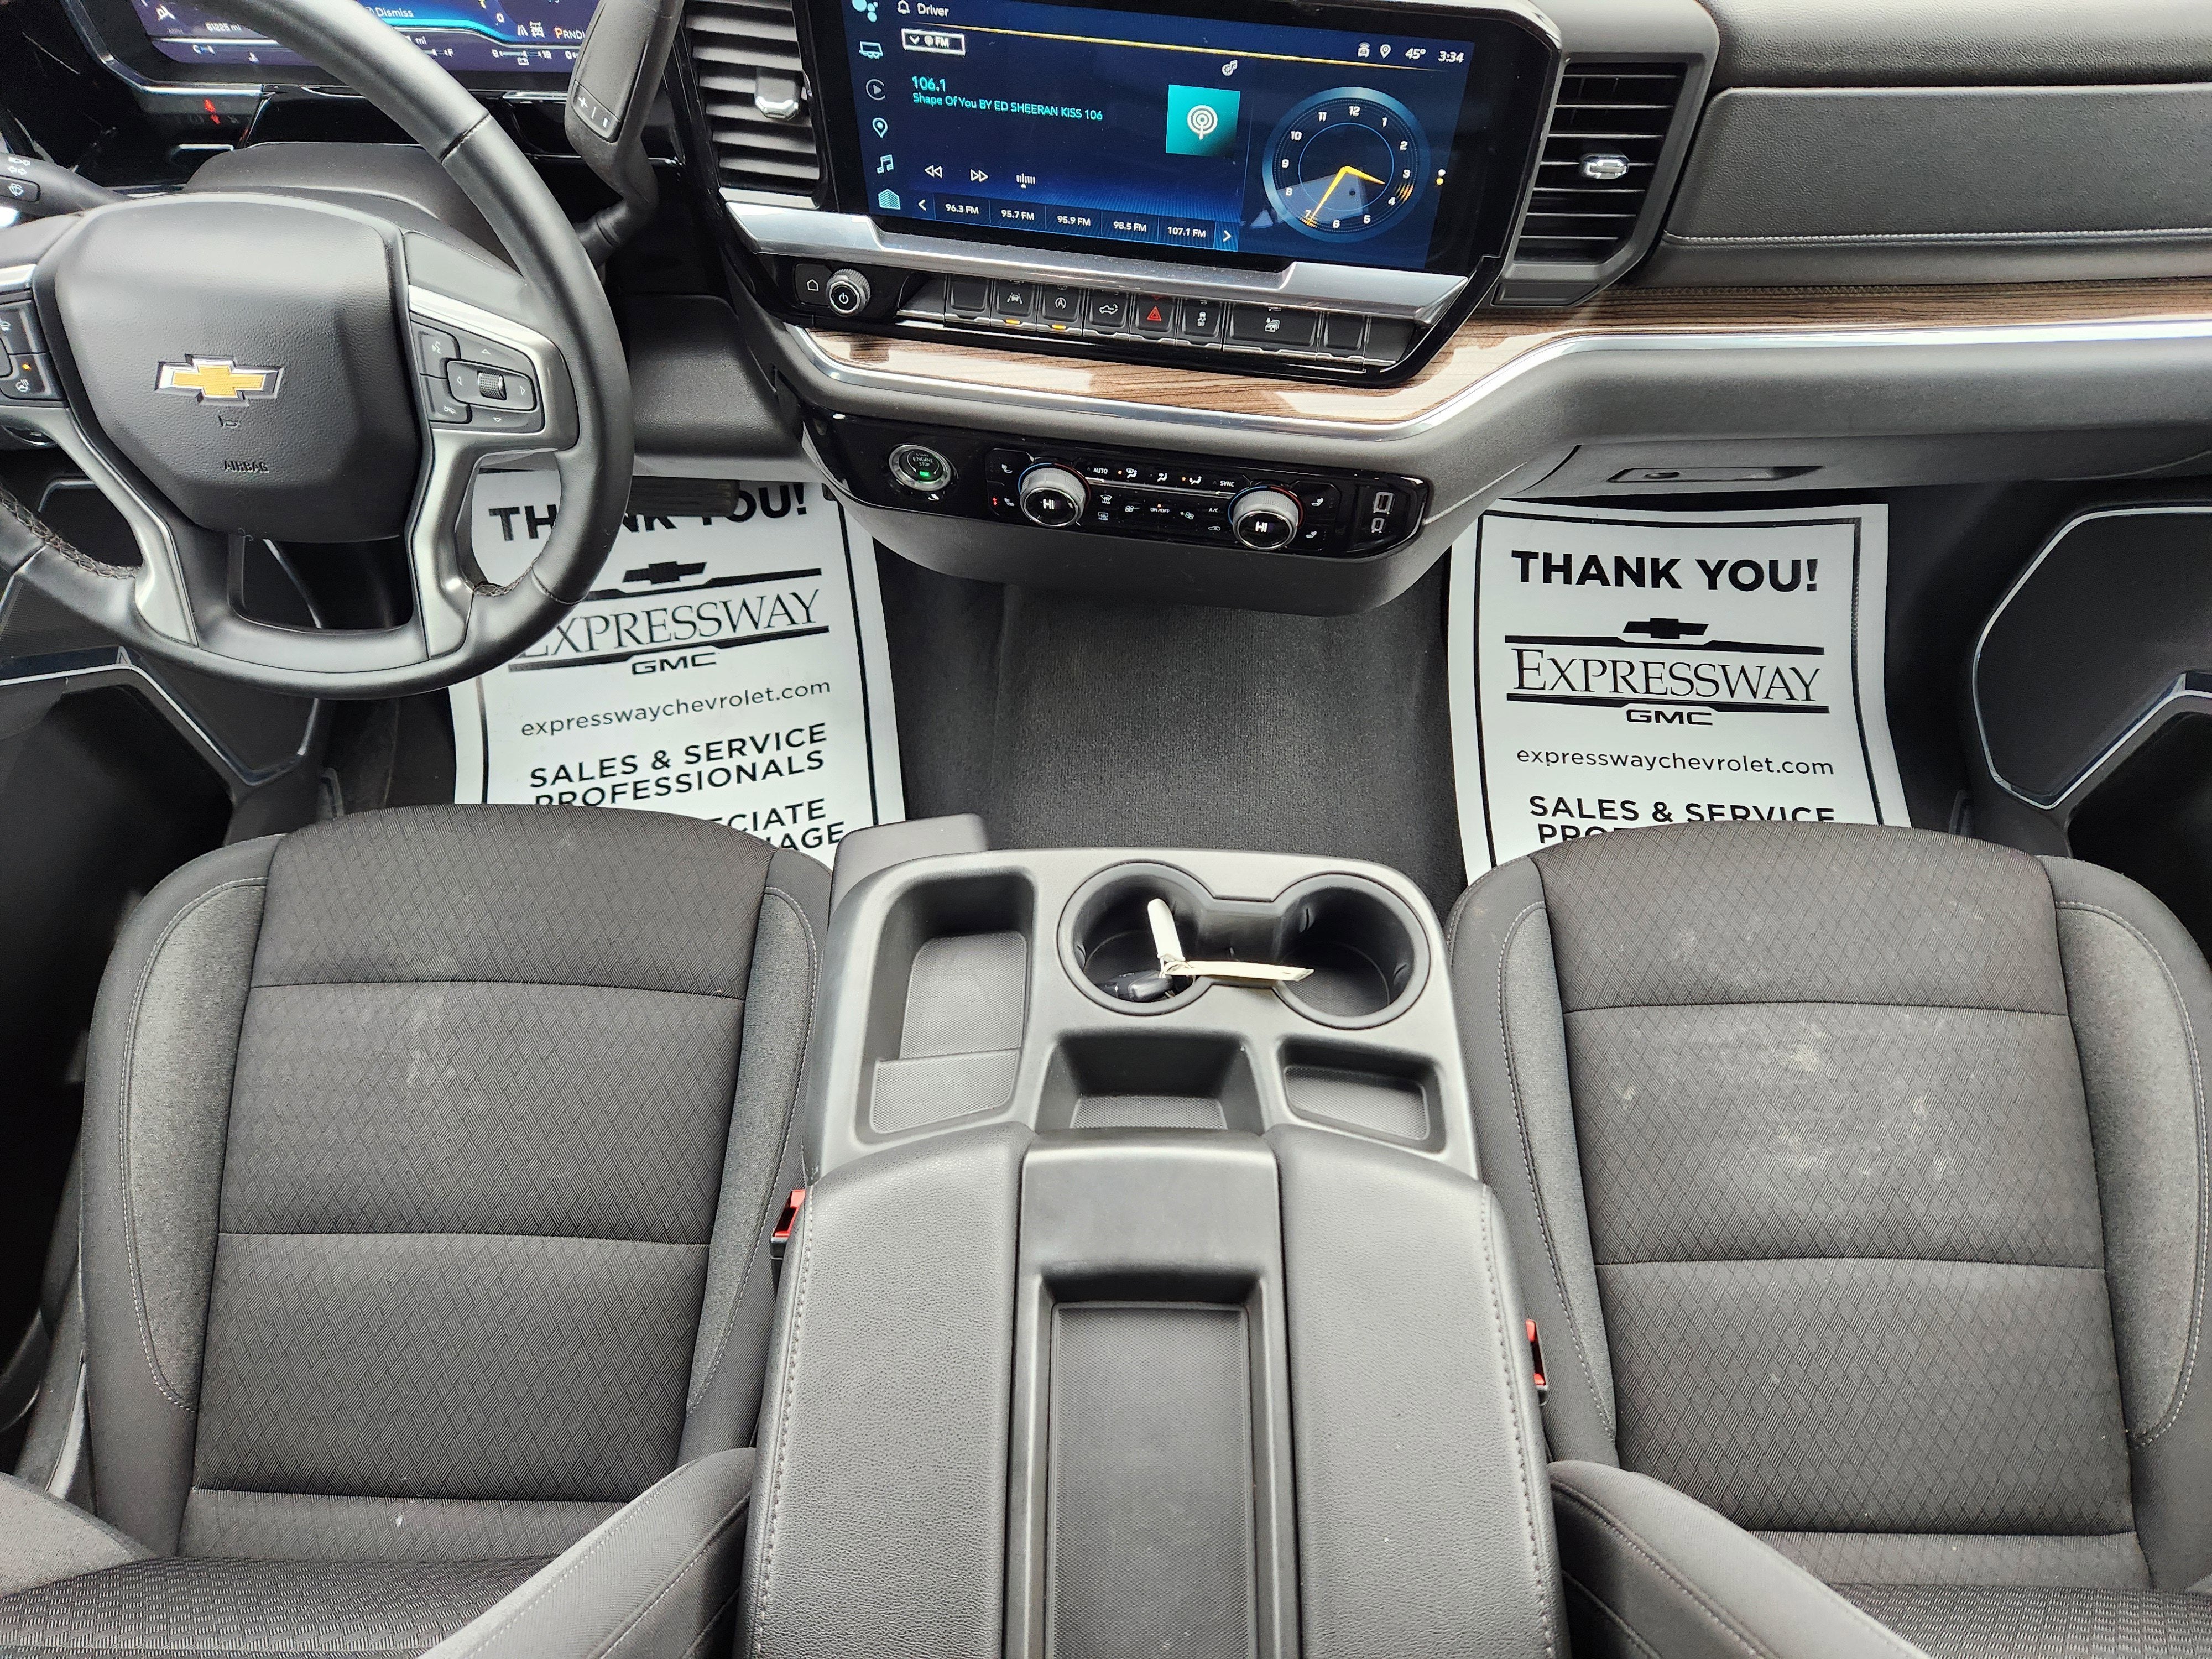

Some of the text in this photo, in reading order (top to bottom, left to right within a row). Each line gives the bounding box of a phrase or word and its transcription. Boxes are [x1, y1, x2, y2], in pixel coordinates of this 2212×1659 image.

[375, 7, 414, 17] Dismiss
[917, 3, 950, 18] Driver
[935, 36, 950, 48] FM
[1405, 48, 1464, 63] 45° 3:34
[912, 76, 946, 92] 106.1
[913, 92, 1103, 121] Shape Of You BY ED SHEERAN KISS 106
[1349, 106, 1360, 117] 12
[1318, 112, 1327, 122] 11
[1383, 117, 1387, 128] 1
[1291, 131, 1302, 141] 10
[1400, 141, 1408, 151] 2
[1282, 159, 1289, 169] 9
[1402, 169, 1411, 179] 3
[1286, 187, 1292, 196] 8
[1388, 197, 1396, 206] 4
[945, 204, 979, 215] 96.3 FM
[1001, 209, 1035, 221] 95.7 FM
[1057, 215, 1091, 226] 95.9 FM
[1333, 220, 1340, 228] 6
[1363, 215, 1371, 223] 5
[1113, 221, 1147, 232] 98.5 FM
[1167, 226, 1206, 238] 107.1 FM
[223, 460, 270, 473] AIRBAG
[1219, 479, 1235, 488] SYNC
[702, 483, 807, 526] OU!
[1043, 498, 1055, 510] HI
[1255, 521, 1268, 533] HI
[1511, 550, 1818, 592] THANK YOU!
[515, 589, 820, 659] XPRESSWAY
[632, 651, 717, 675] GMC
[1511, 648, 1822, 702] EXPRESSWAY
[521, 680, 831, 737] expresswaychevrolet.com
[1626, 709, 1714, 726] GMC
[530, 722, 827, 788] SALES & SERVICE
[1517, 748, 1834, 775] expresswaychevrolet.com
[1530, 795, 1639, 821] SALES
[1652, 801, 1674, 822] &
